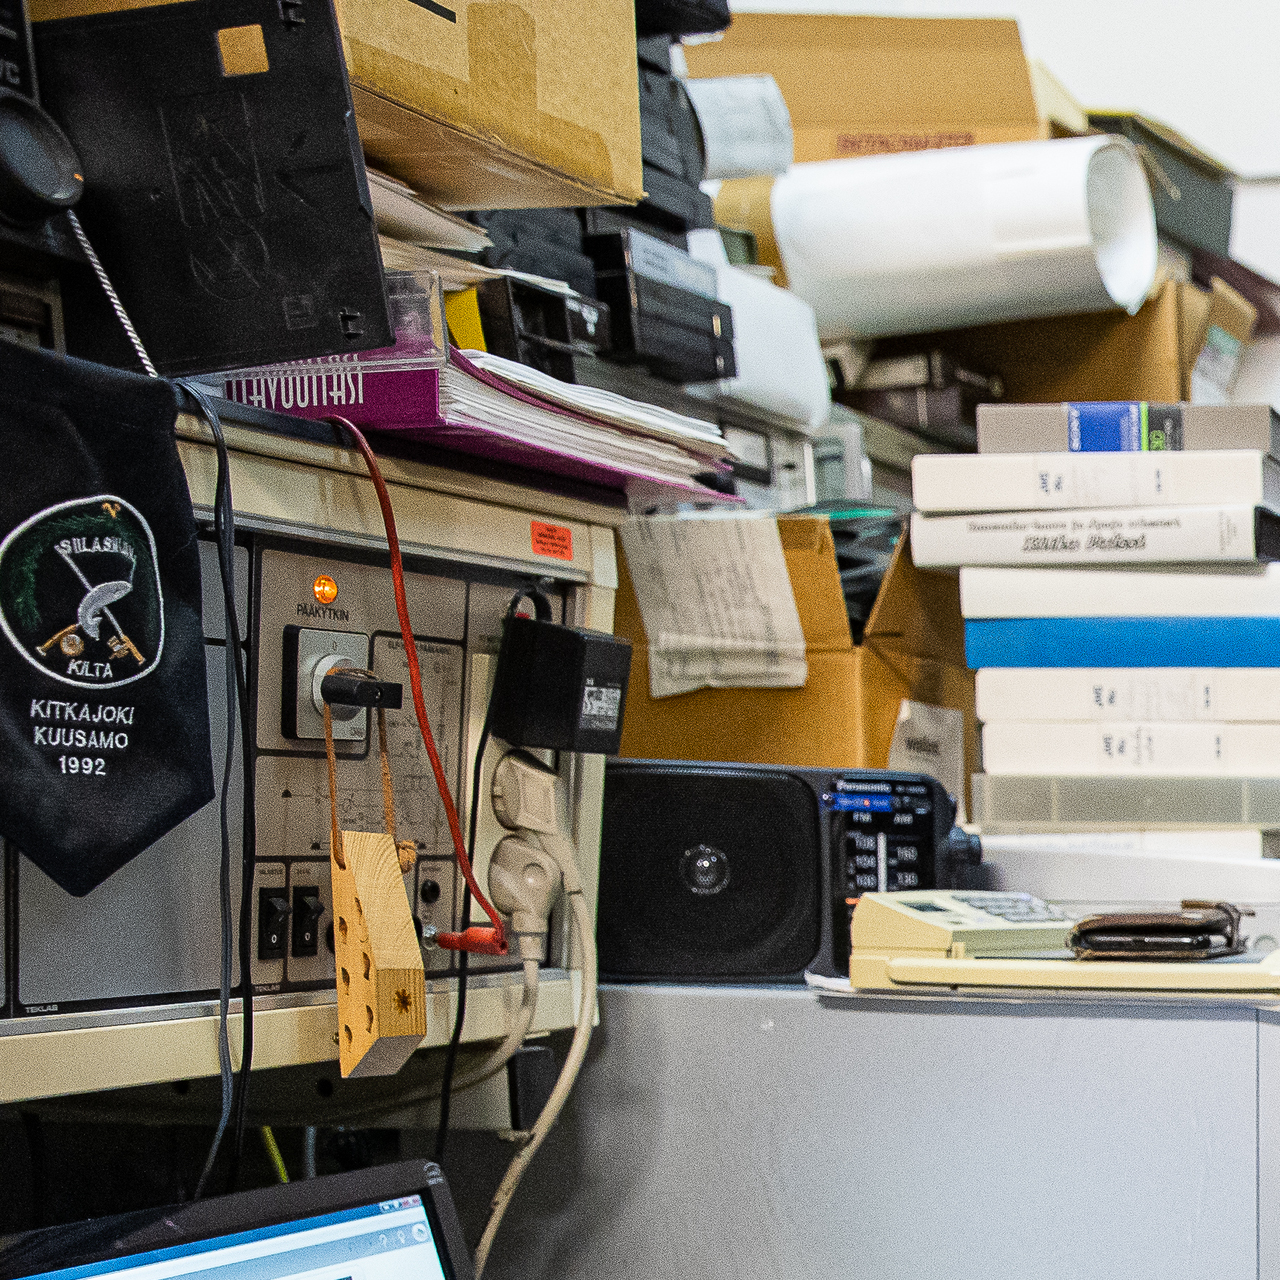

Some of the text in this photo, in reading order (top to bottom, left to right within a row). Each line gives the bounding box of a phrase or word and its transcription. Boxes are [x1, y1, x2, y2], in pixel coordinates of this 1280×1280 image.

[66, 659, 114, 679] KILTA
[29, 698, 135, 725] KITKAJOKI
[33, 725, 129, 749] KUUSAMO
[58, 755, 107, 776] 1992
